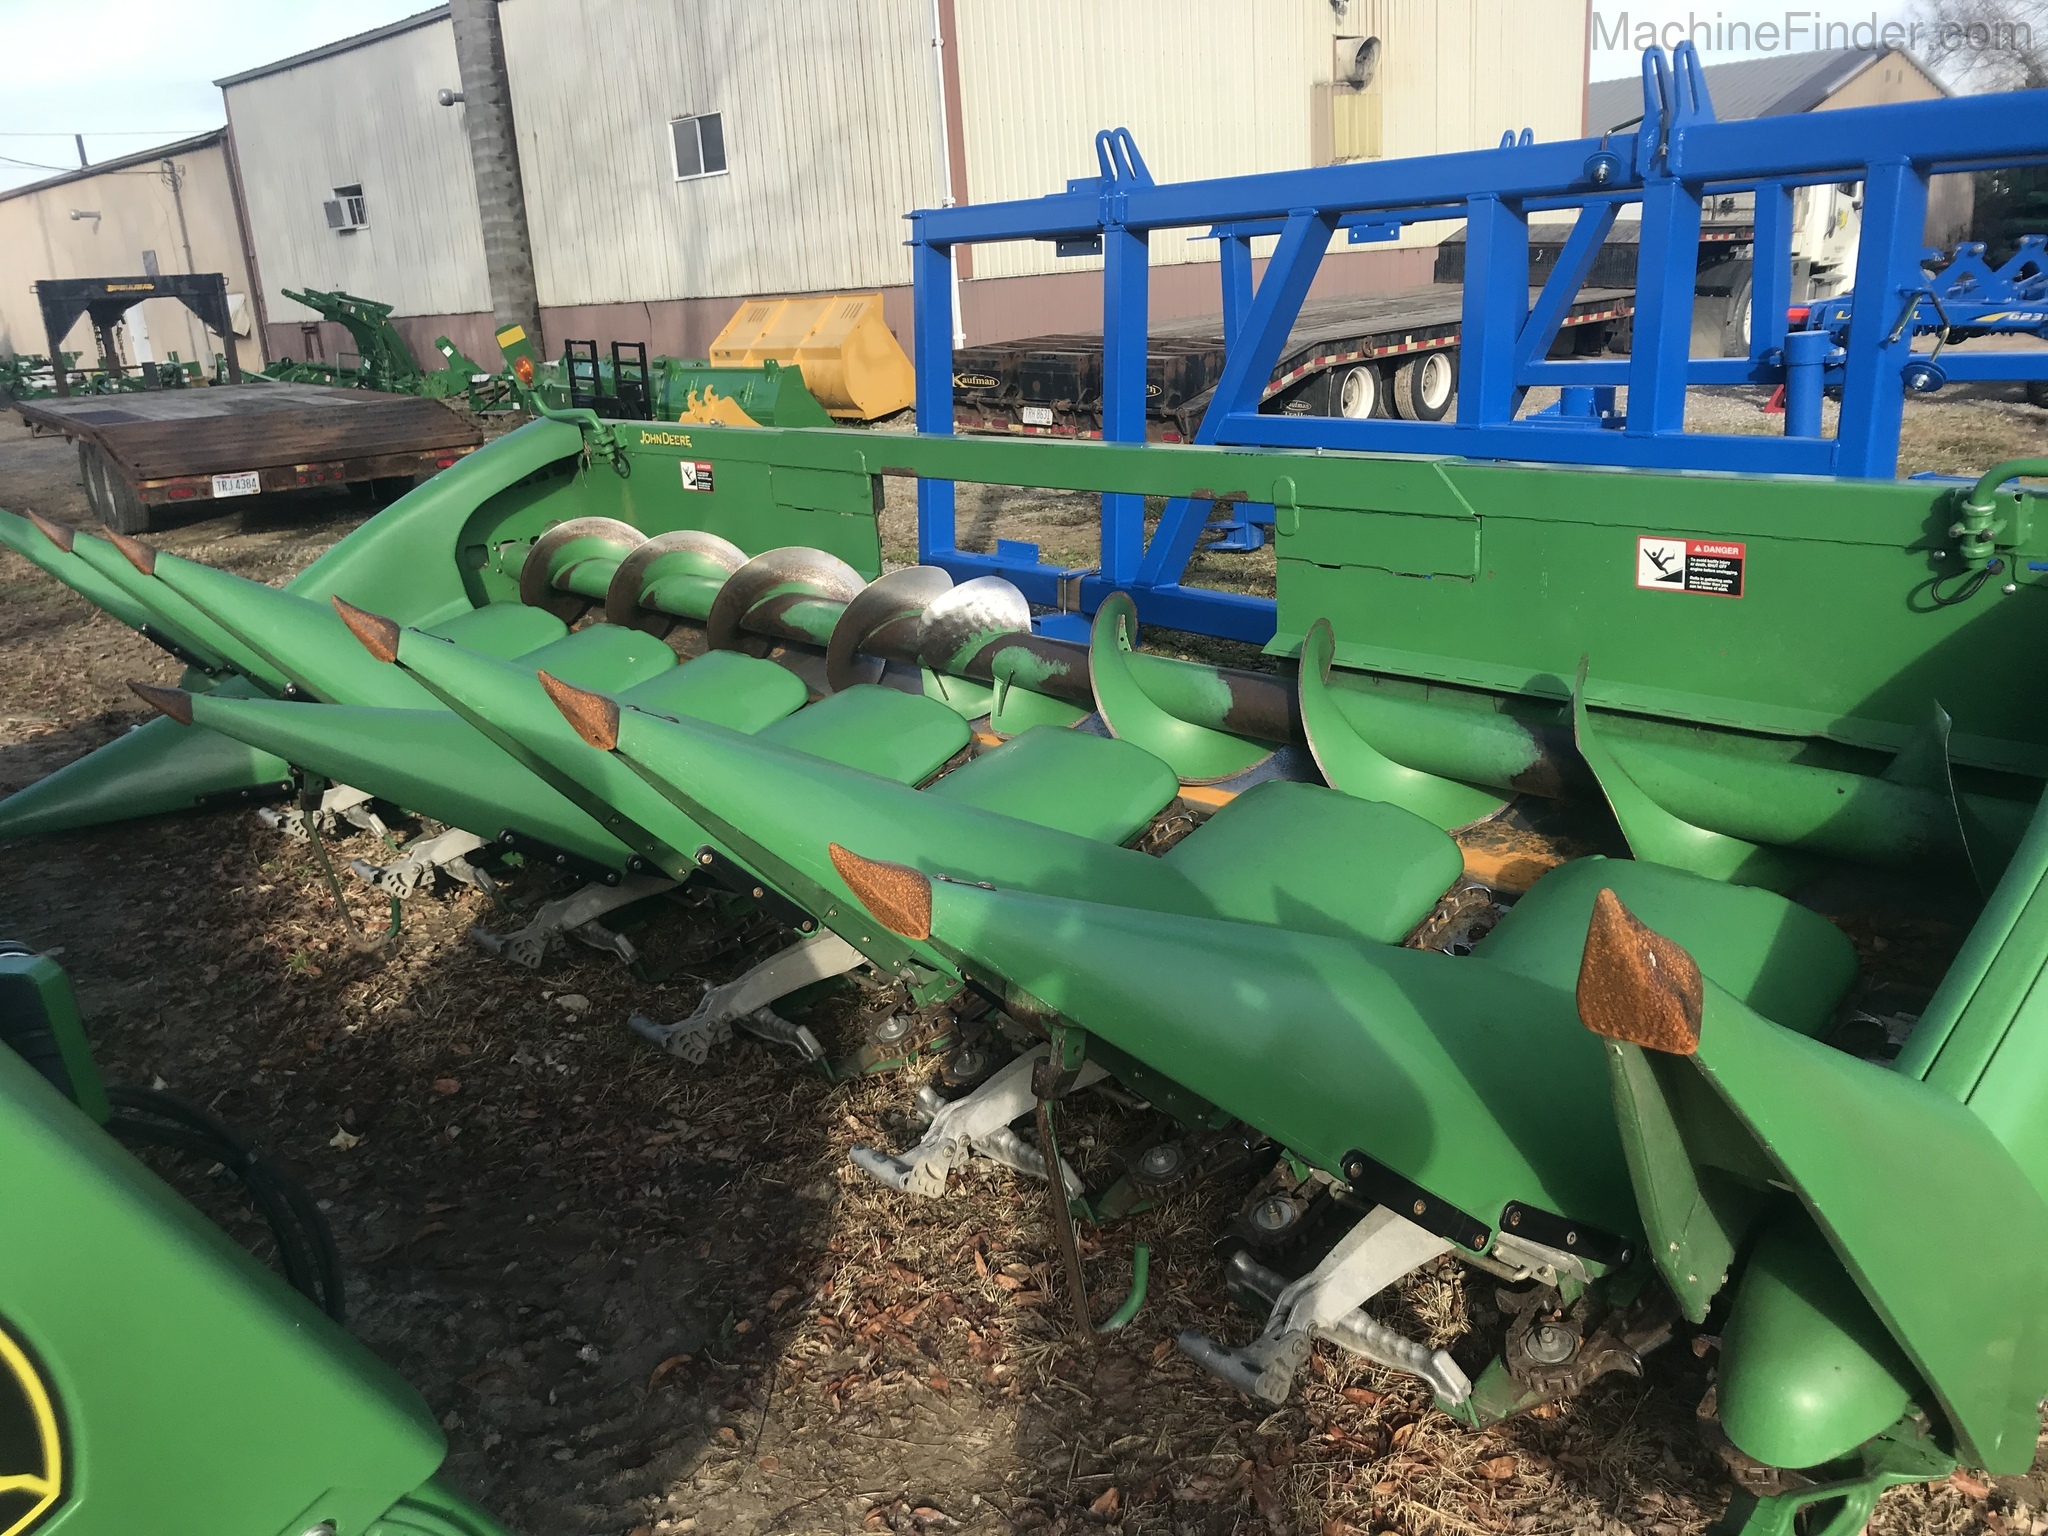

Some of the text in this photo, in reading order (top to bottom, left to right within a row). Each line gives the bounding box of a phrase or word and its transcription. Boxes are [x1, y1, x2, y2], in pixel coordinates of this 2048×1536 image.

[952, 373, 995, 388] Kaufman
[640, 430, 693, 448] JOHN DEERE
[216, 478, 257, 491] TRJ 4384
[1703, 545, 1739, 555] DANGER
